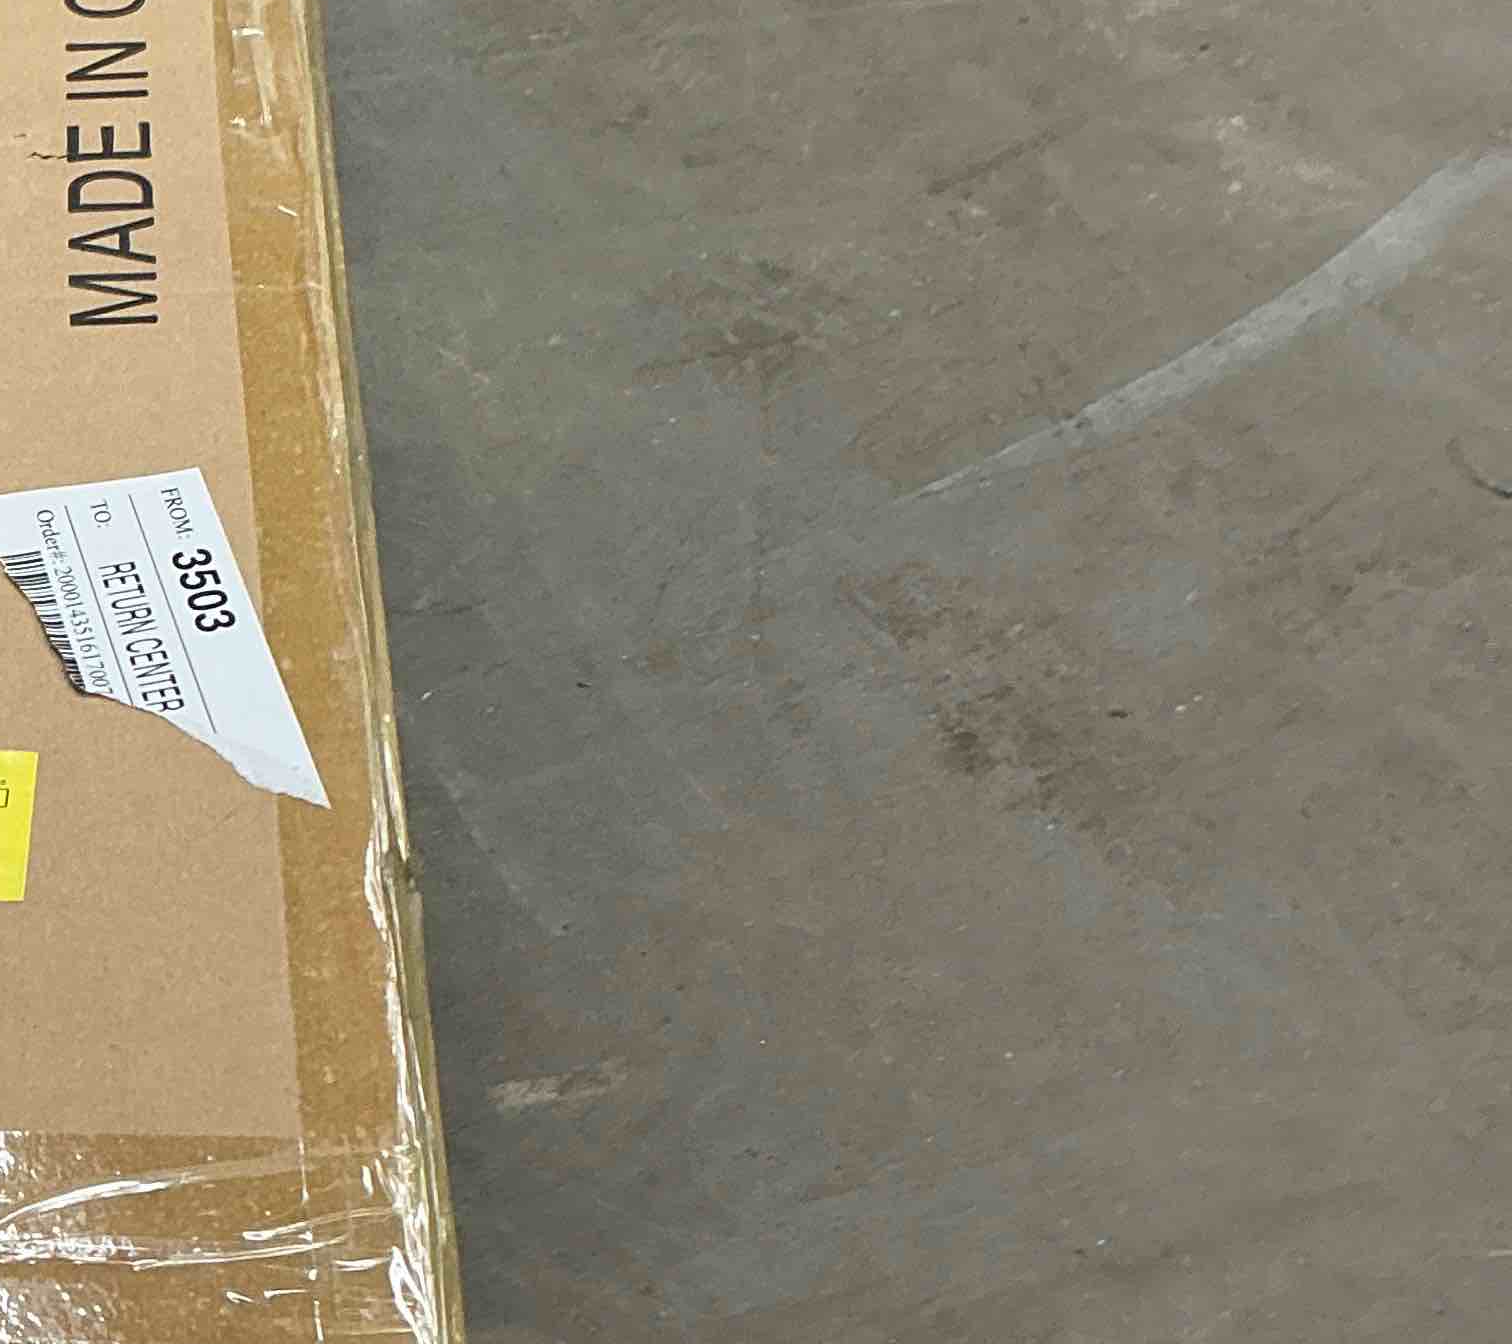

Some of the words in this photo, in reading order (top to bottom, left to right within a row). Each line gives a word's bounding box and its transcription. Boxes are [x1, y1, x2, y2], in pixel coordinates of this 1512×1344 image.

[64, 41, 149, 101] IN
[66, 121, 158, 328] MADE
[90, 500, 112, 528] TO:
[160, 487, 193, 541] FROM:
[98, 560, 148, 636] RETURN
[172, 547, 236, 633] 3503
[126, 635, 185, 713] CENTER
